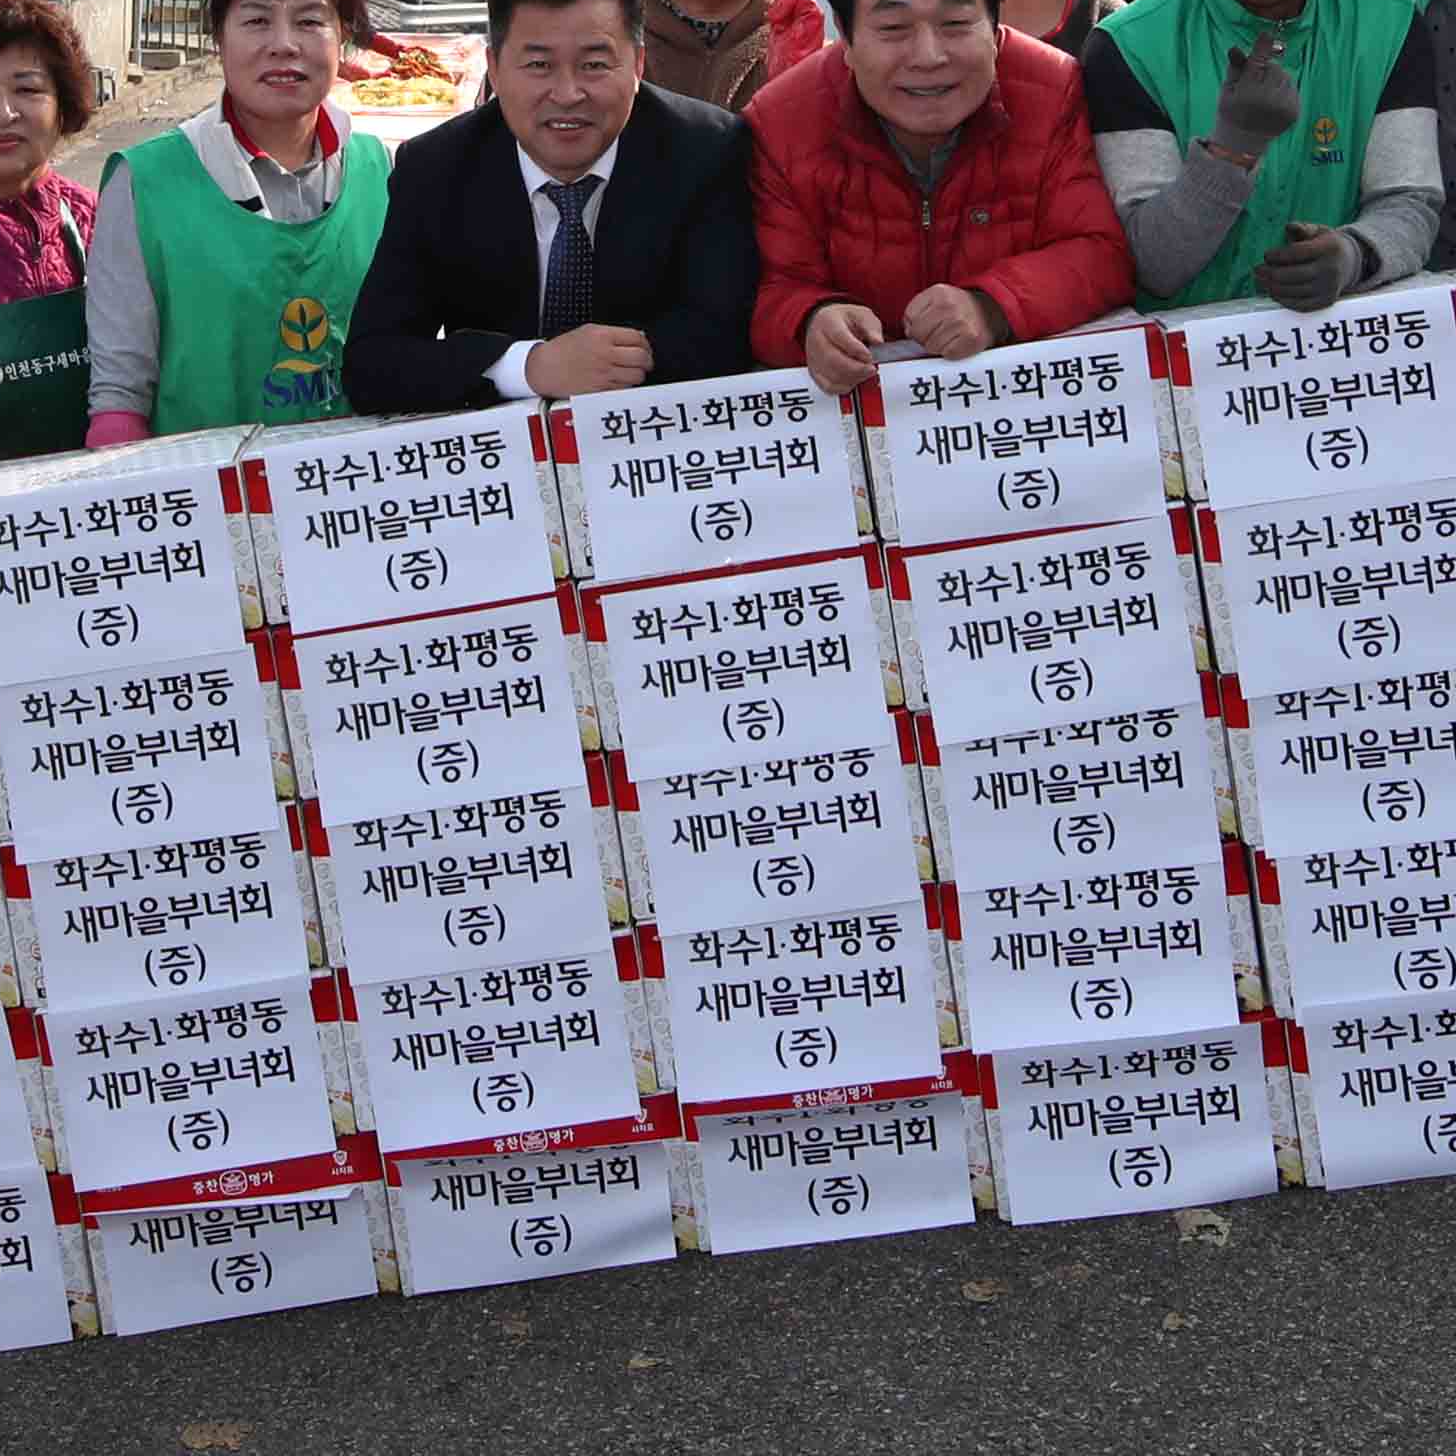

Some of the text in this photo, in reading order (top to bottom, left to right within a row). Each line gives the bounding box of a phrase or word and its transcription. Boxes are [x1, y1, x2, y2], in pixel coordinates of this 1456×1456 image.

[1222, 361, 1437, 427] 새마을부녀회
[915, 403, 1130, 466] 새마을부녀회
[1305, 424, 1370, 472] (증)
[609, 434, 821, 500] 새마을부녀회
[996, 466, 1061, 512] (증)
[304, 480, 515, 550] 새마을부녀회
[689, 497, 754, 544] (증)
[385, 546, 449, 594] (증)
[76, 602, 140, 650] (증)
[946, 591, 1160, 662] 새마을부녀회
[640, 632, 852, 700] 새마을부녀회
[334, 673, 547, 743] 새마을부녀회
[30, 717, 242, 782] 새마을부녀회
[970, 749, 1185, 812] 새마을부녀회
[670, 788, 883, 855] 새마을부녀회
[361, 839, 574, 904] 새마을부녀회
[62, 879, 274, 945] 새마을부녀회
[989, 916, 1204, 972] 새마을부녀회
[694, 964, 907, 1024] 새마을부녀회
[390, 1008, 602, 1073] 새마을부녀회
[85, 1044, 297, 1112] 새마을부녀회
[726, 1113, 939, 1173] 새마을부녀회
[1026, 1082, 1242, 1142] 새마을부녀회
[428, 1152, 641, 1213] 새마을부녀회
[806, 1172, 871, 1218] (증)
[1108, 1143, 1173, 1190] (증)
[509, 1212, 573, 1260] (증)
[209, 1249, 274, 1296] (증)
